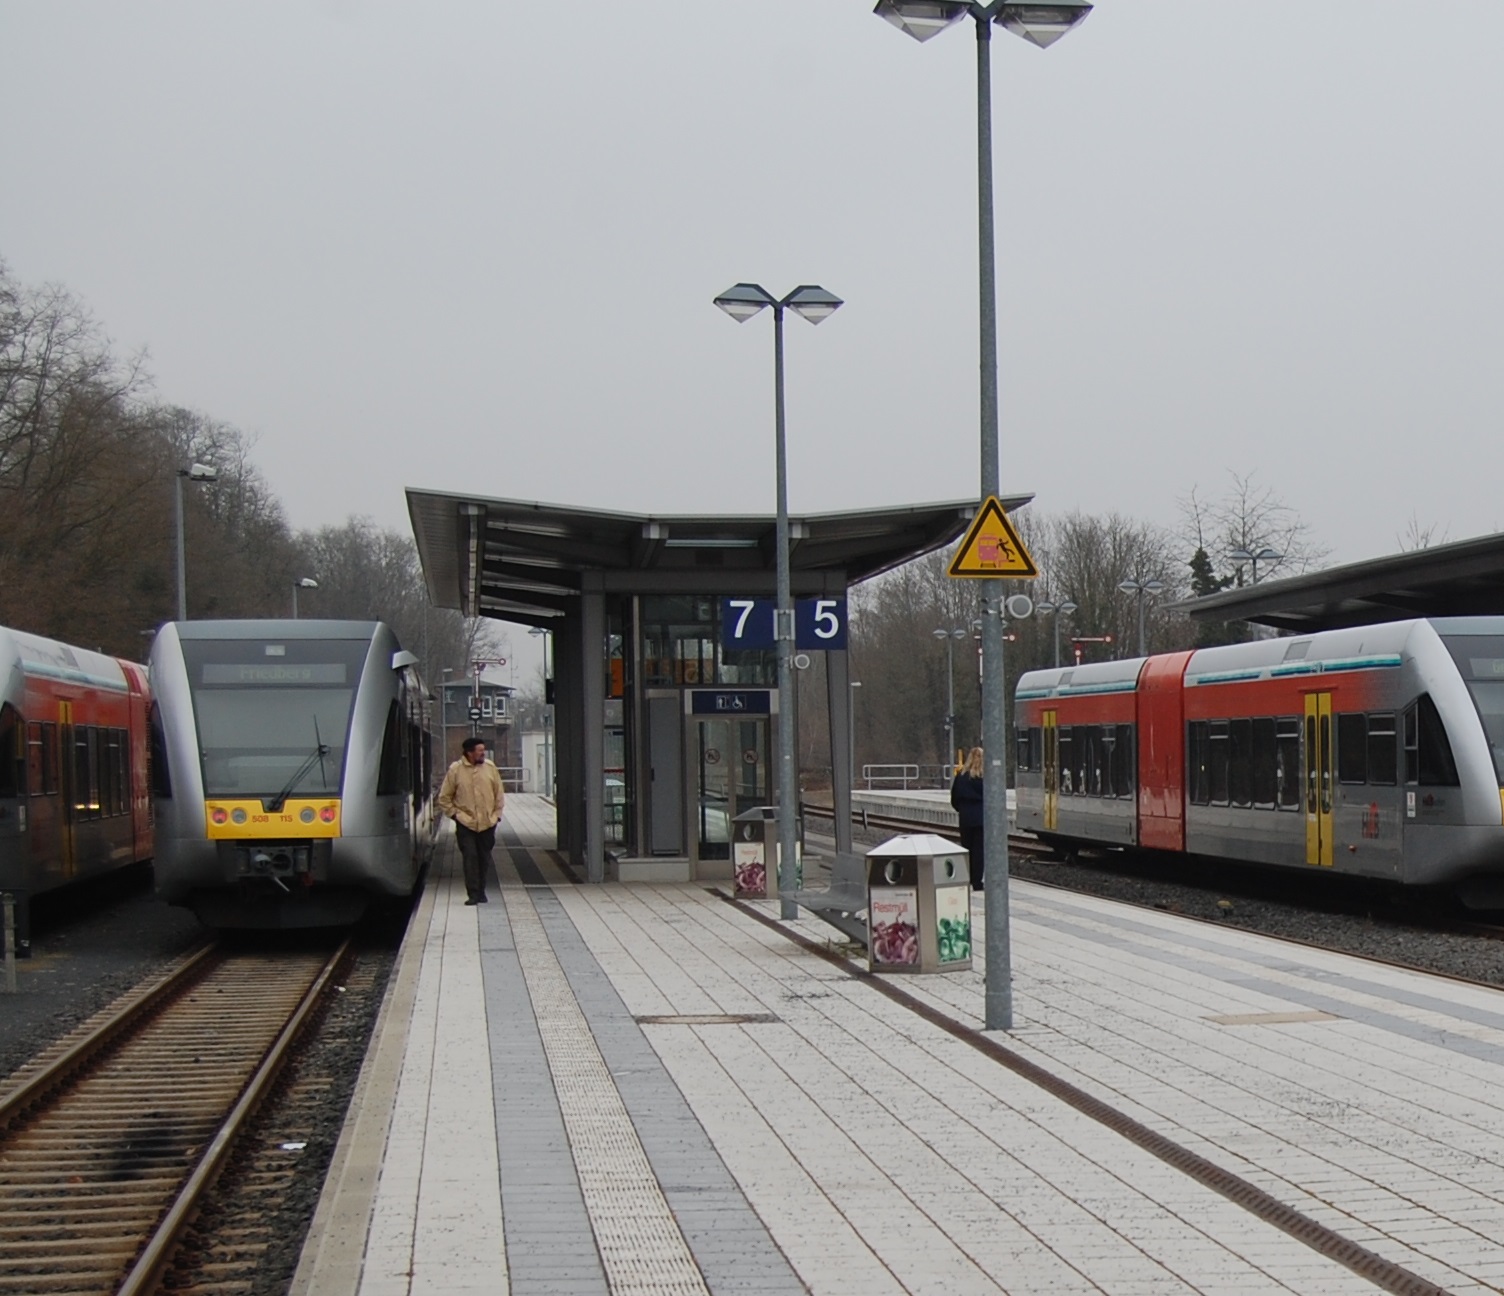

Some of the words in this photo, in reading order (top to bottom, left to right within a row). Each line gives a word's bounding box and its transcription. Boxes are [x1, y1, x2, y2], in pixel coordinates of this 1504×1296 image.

[729, 600, 755, 638] 7
[814, 600, 839, 638] 5
[241, 667, 311, 680] Friedberg
